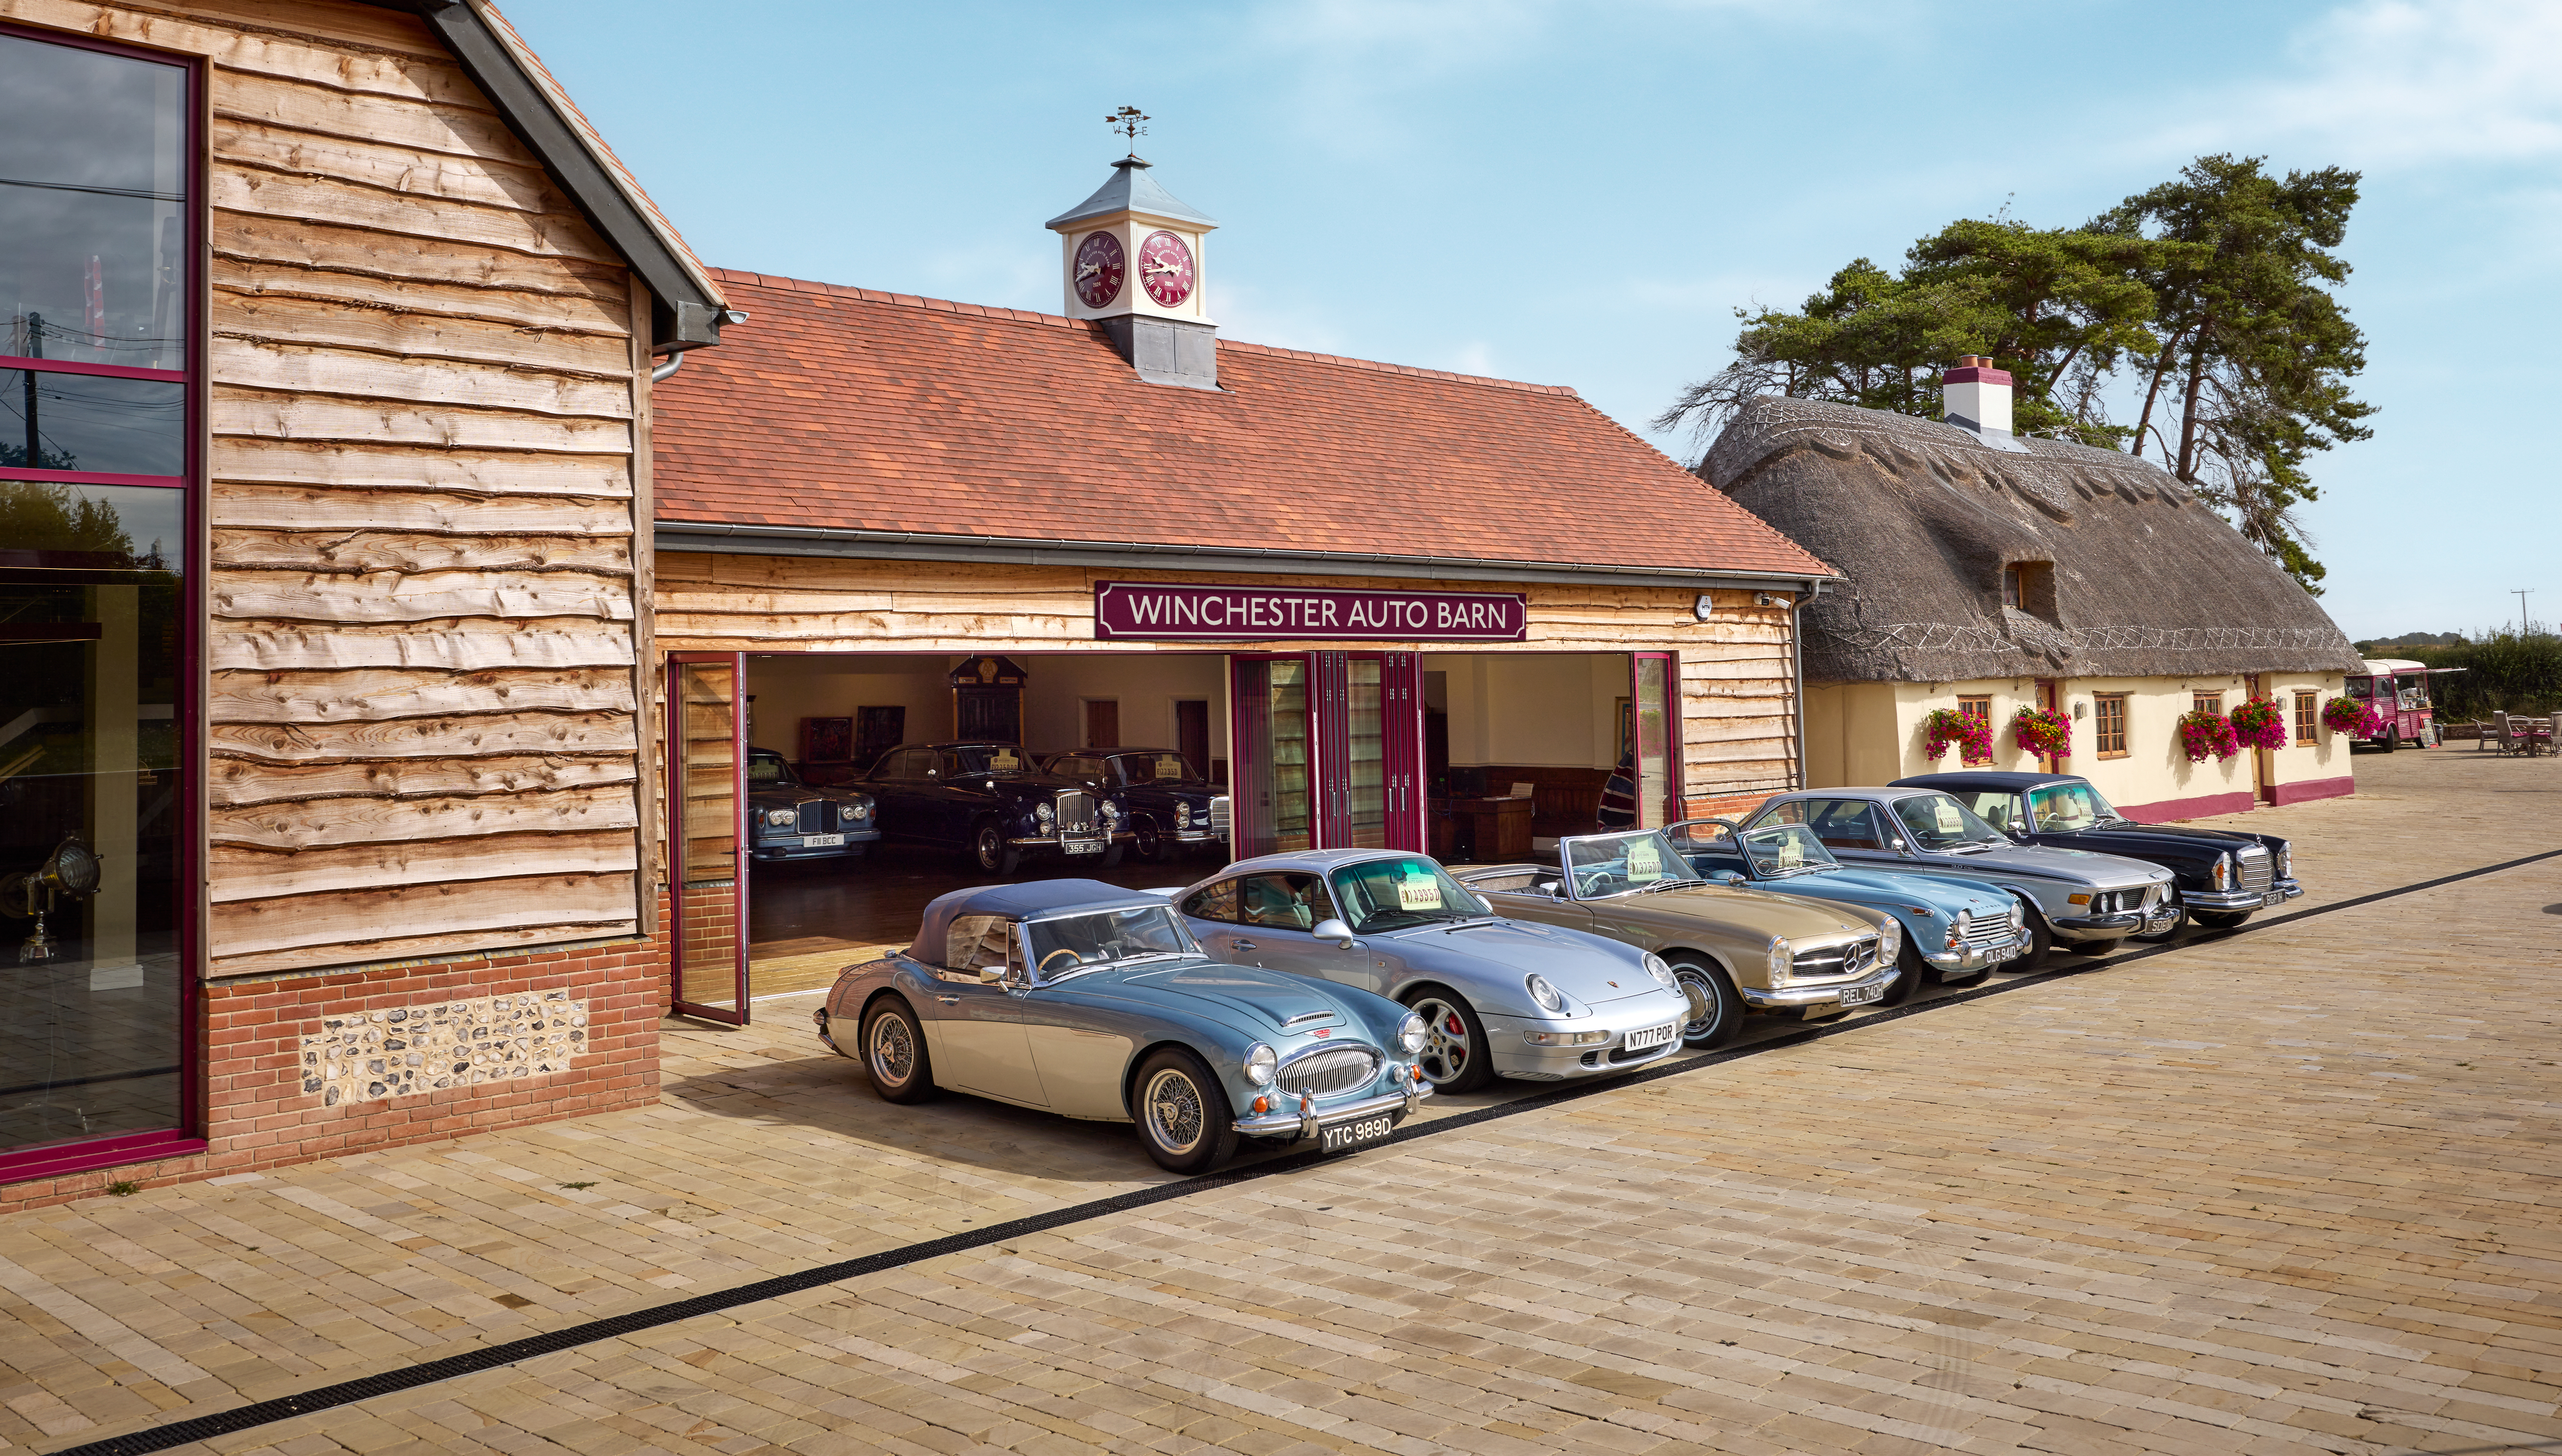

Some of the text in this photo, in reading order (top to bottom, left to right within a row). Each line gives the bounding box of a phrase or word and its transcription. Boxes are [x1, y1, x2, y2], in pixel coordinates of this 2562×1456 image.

[1113, 126, 1121, 134] W
[1142, 127, 1148, 135] E
[1171, 251, 1179, 259] AUTO
[1128, 594, 1506, 629] WINCHESTER AUTO BARN
[1069, 843, 1101, 852] 355 JGH
[1629, 861, 1661, 874] £137500
[1401, 888, 1439, 903] £149950
[2267, 893, 2277, 905] BGP
[2152, 921, 2167, 931] SDE
[1987, 946, 2016, 963] OLG 941D
[1843, 983, 1883, 1004] REL 740H
[1630, 1025, 1672, 1047] N777 POR
[1324, 1117, 1391, 1148] YTC 989D
